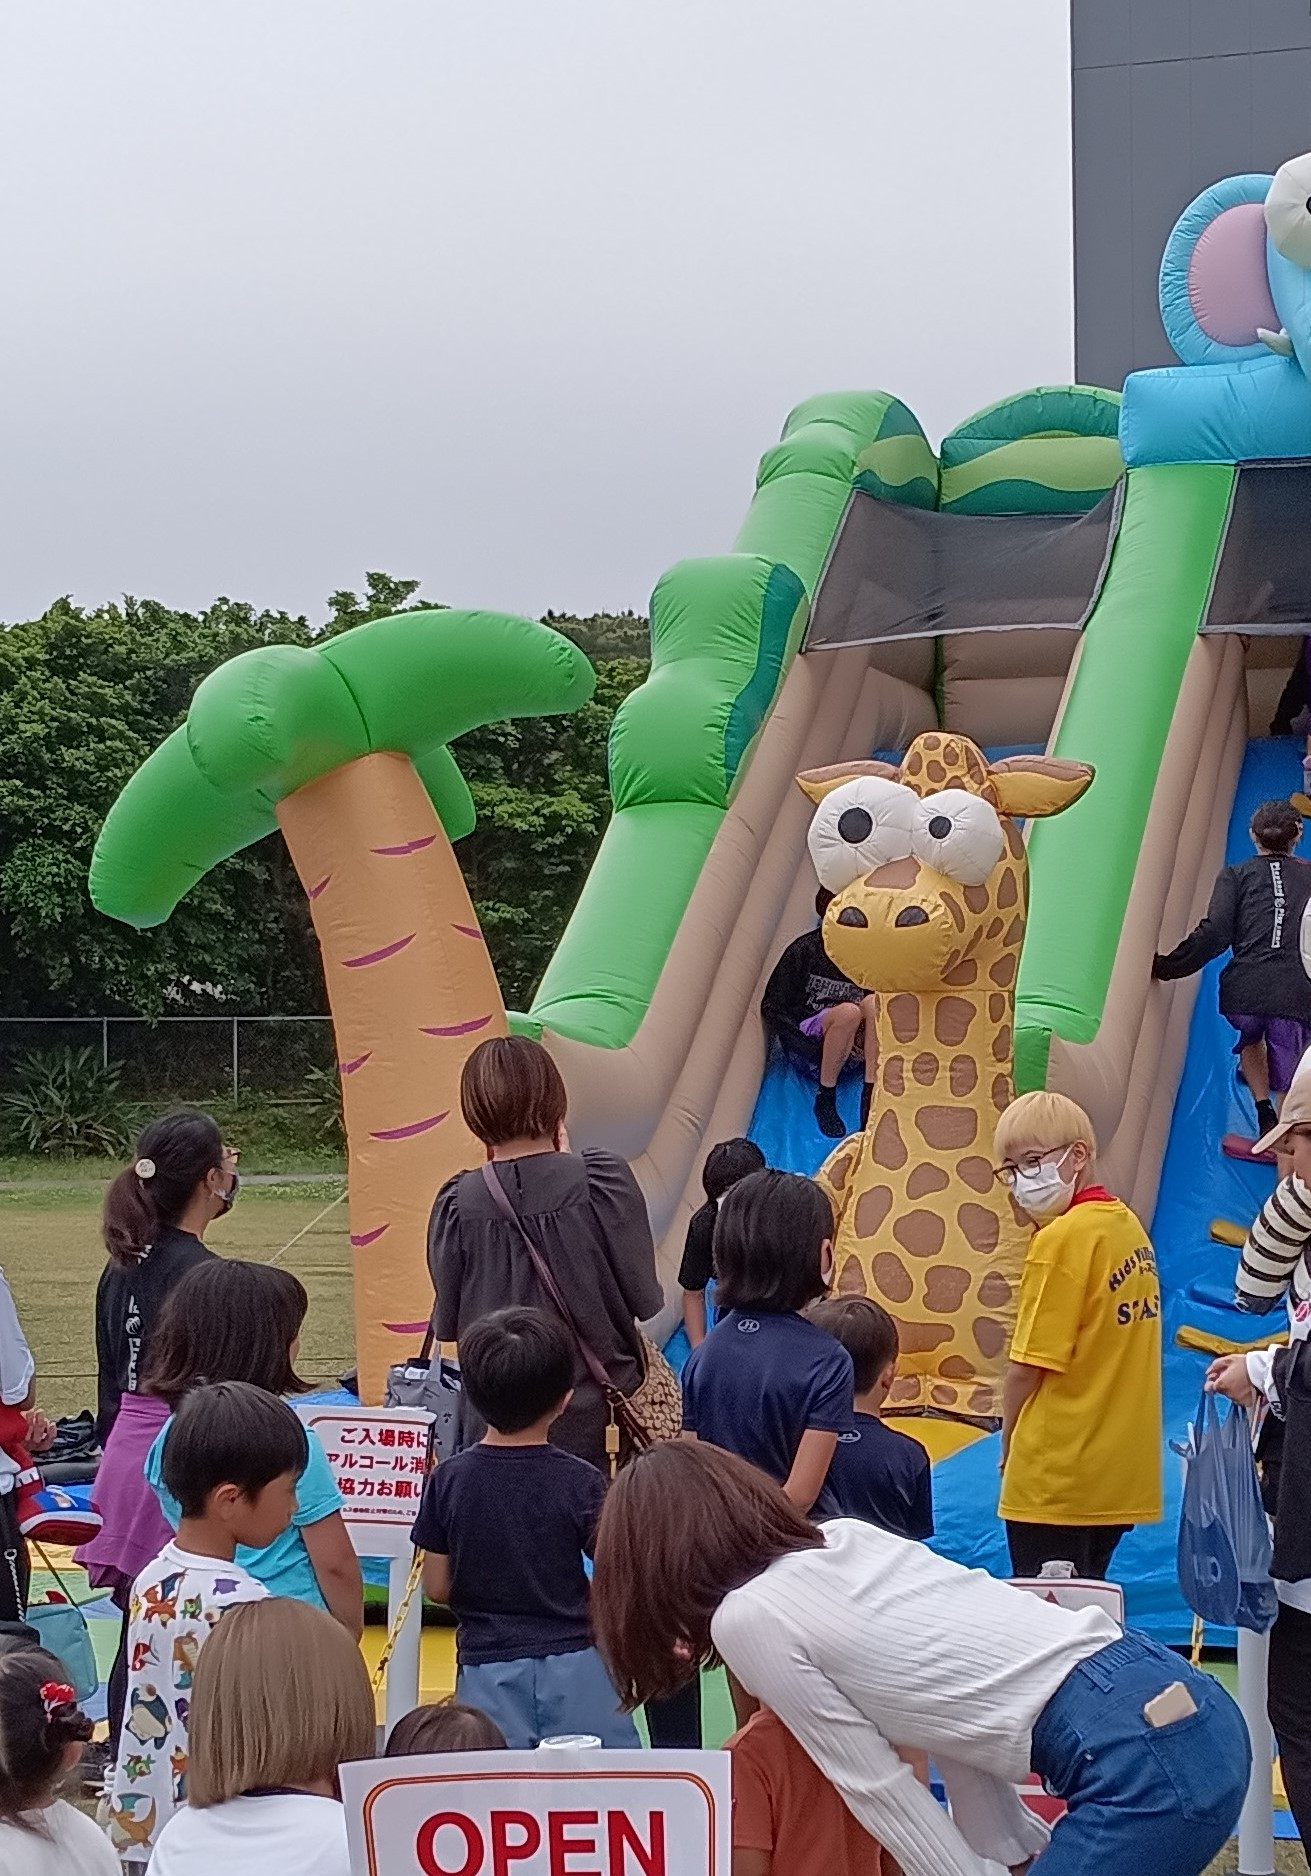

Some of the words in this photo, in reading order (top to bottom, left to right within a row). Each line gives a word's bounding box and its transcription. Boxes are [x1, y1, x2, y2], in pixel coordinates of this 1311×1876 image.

[340, 1427, 427, 1449] ご入場時に
[416, 1810, 667, 1876] OPEN
